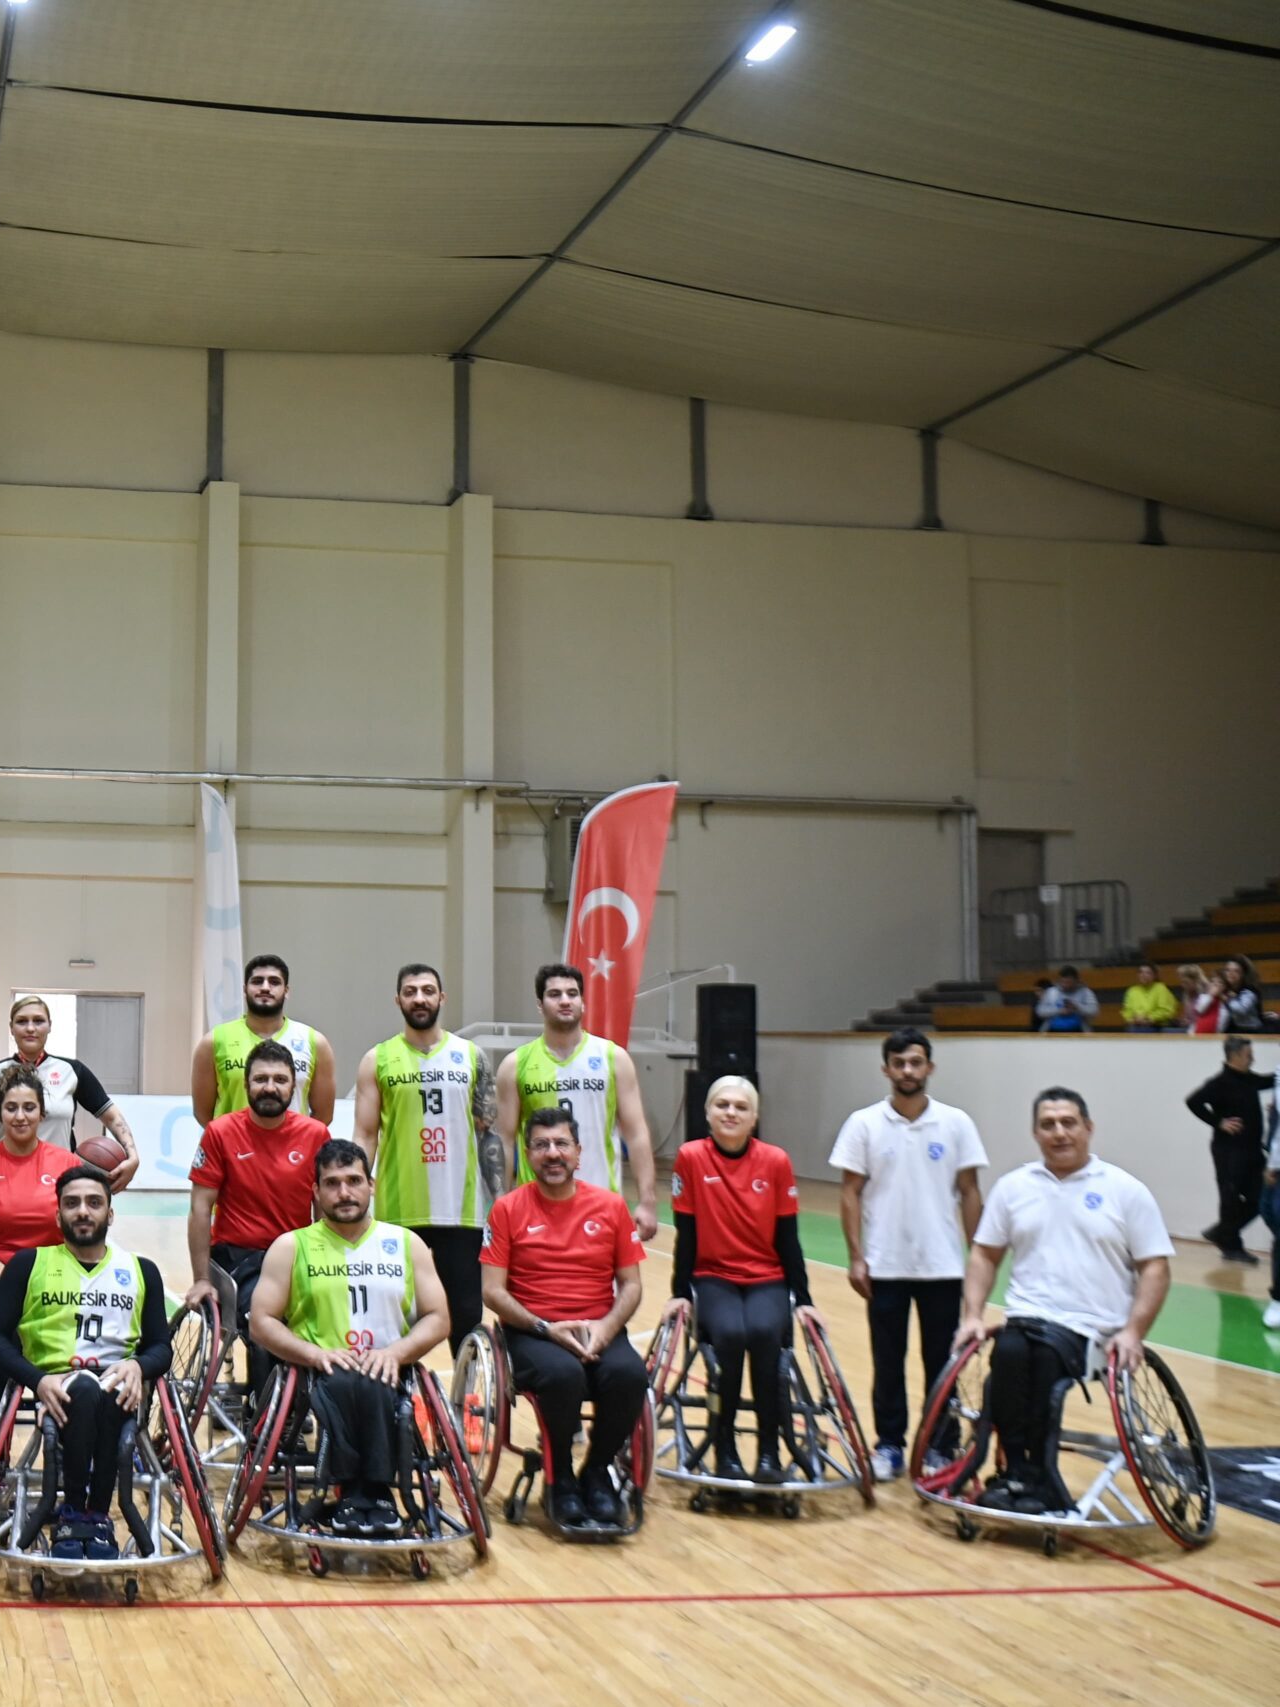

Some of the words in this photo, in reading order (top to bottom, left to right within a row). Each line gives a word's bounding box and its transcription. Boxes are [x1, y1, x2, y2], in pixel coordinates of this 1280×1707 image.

[387, 1068, 445, 1087] BALIKESİR
[448, 1070, 468, 1084] BŞB
[524, 1077, 580, 1095] BALIKESİR
[583, 1078, 604, 1091] BŞB
[418, 1088, 443, 1115] 13
[308, 1260, 373, 1277] BALIKESİR
[377, 1263, 403, 1278] BŞB
[41, 1289, 107, 1307] BALIKESİR
[111, 1293, 133, 1311] BŞB
[348, 1284, 368, 1315] 11
[74, 1313, 103, 1343] 10
